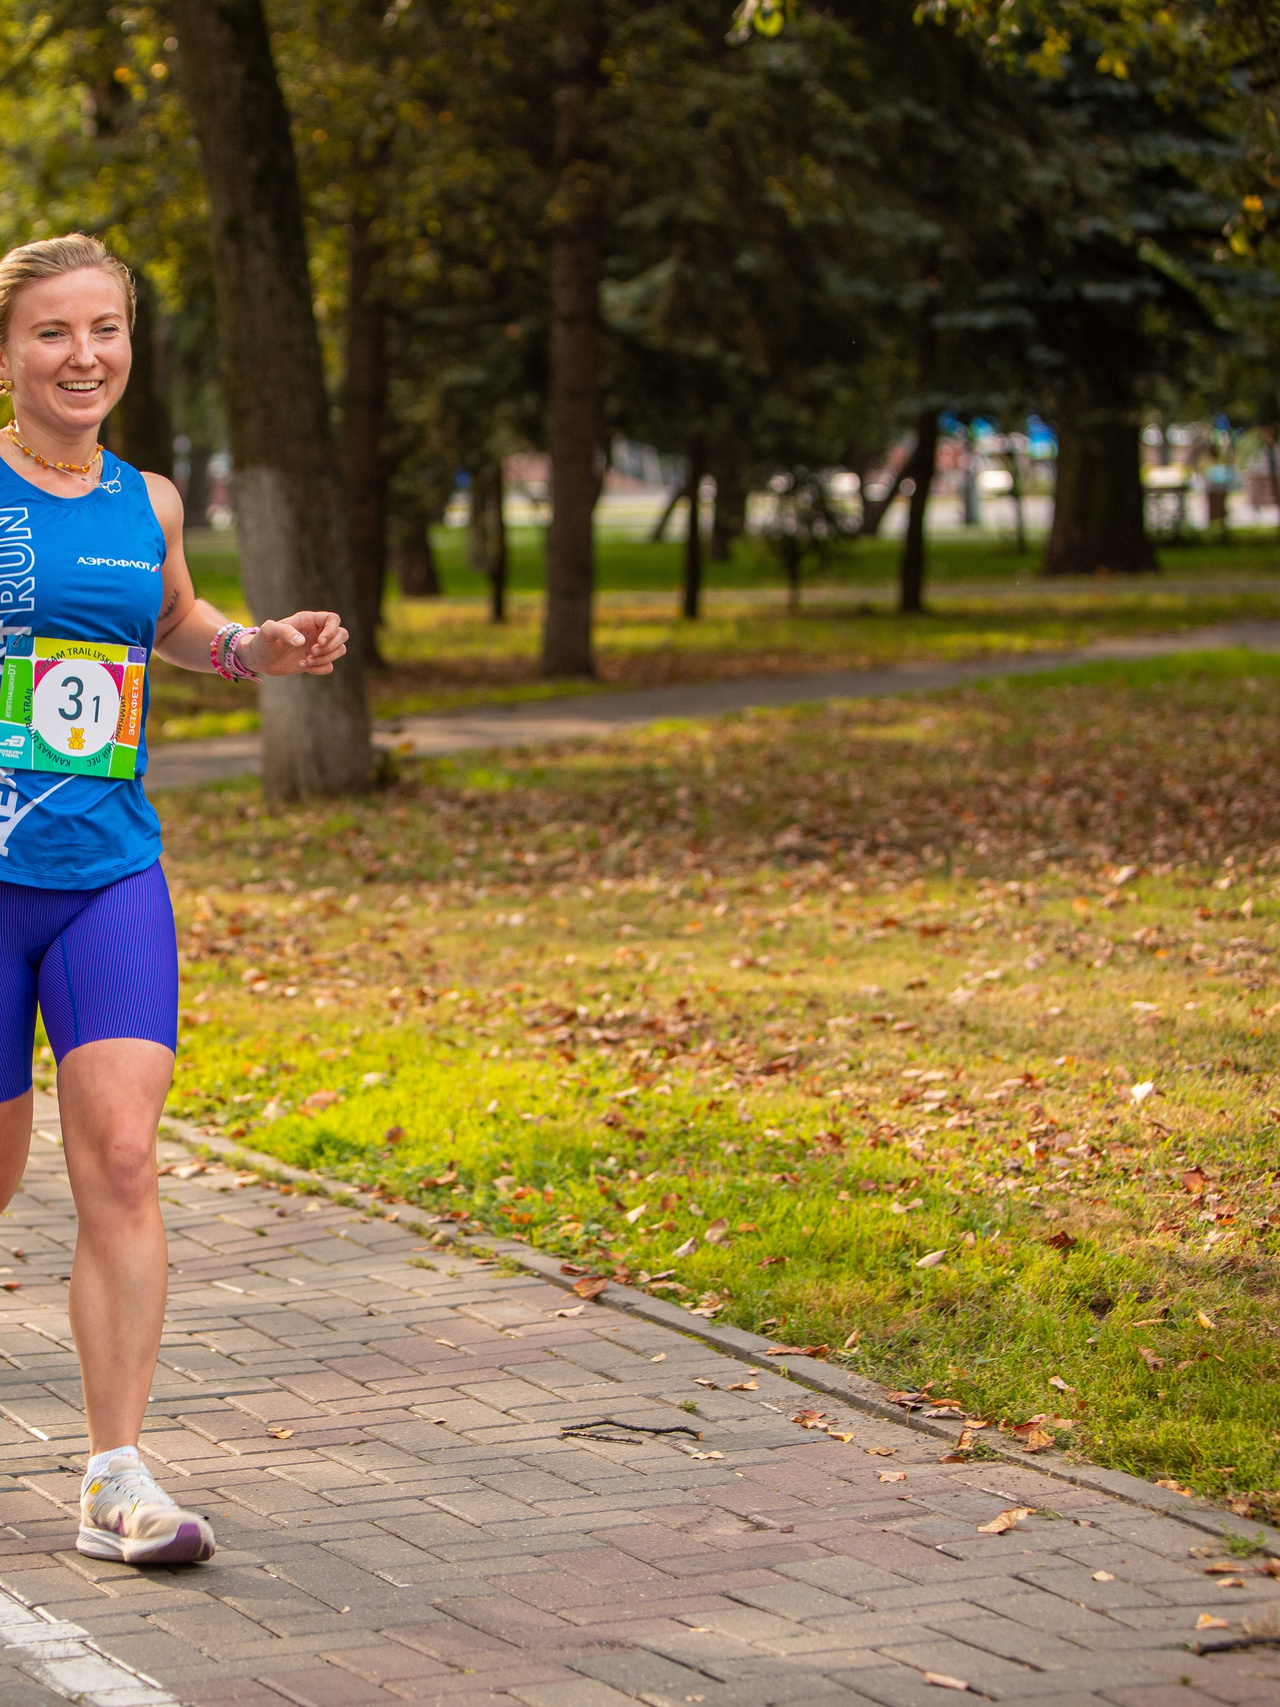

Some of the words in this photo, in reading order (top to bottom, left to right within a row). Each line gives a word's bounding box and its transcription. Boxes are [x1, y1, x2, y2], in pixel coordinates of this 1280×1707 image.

[77, 556, 150, 571] АЭРОФЛОТ
[36, 650, 65, 675] DREAM
[67, 647, 91, 656] TRAIL
[93, 650, 121, 680] LYSKOVO
[23, 687, 34, 713] TRAIL
[128, 677, 140, 736] ЭСТАФЕТА
[102, 695, 126, 759] ХИМКИНСКИЙ
[37, 743, 71, 767] KANNAS
[86, 754, 101, 767] ЛЕС
